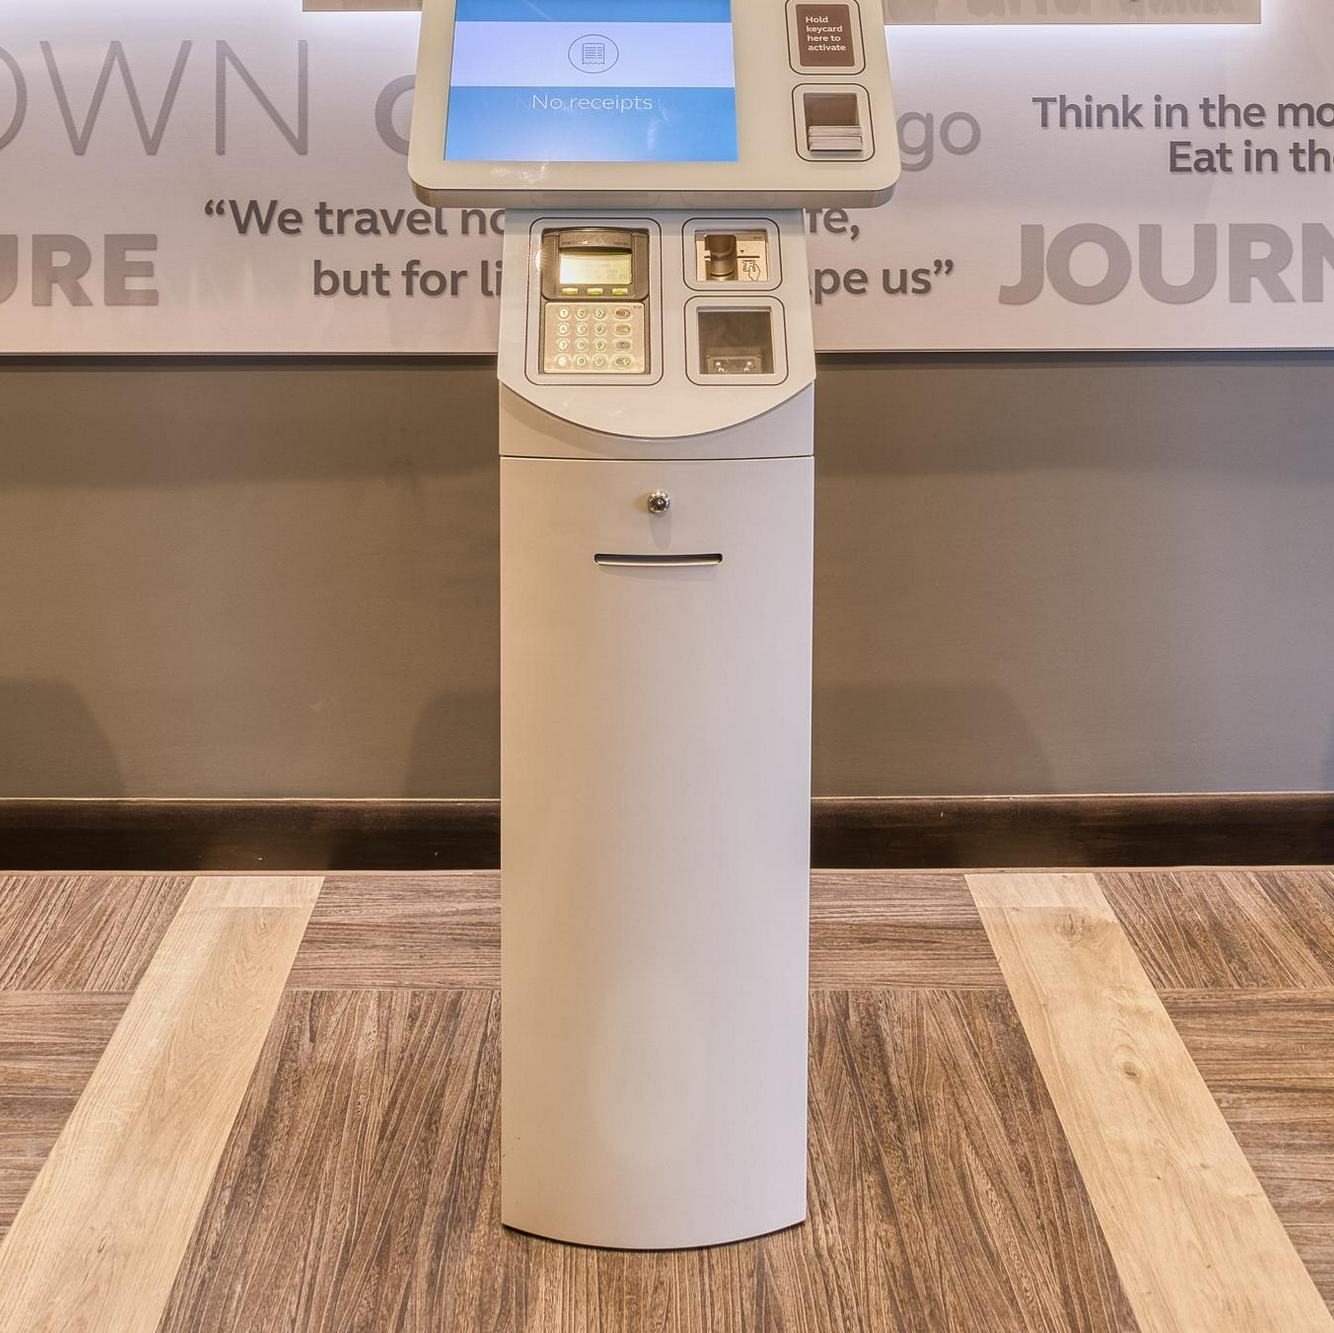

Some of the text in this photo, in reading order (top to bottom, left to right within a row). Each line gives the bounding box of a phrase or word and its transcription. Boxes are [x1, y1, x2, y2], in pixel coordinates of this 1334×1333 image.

[806, 25, 843, 33] keycard
[532, 94, 654, 113] No receipts
[1032, 95, 1143, 129] Think
[1154, 95, 1188, 128] in
[1199, 95, 1266, 128] the
[896, 111, 981, 172] go
[1169, 141, 1234, 173] Eat
[1244, 140, 1279, 172] in
[204, 199, 302, 235] “We
[315, 201, 447, 235] travel
[313, 259, 390, 296] but
[401, 259, 468, 296] for
[882, 259, 954, 295] us”
